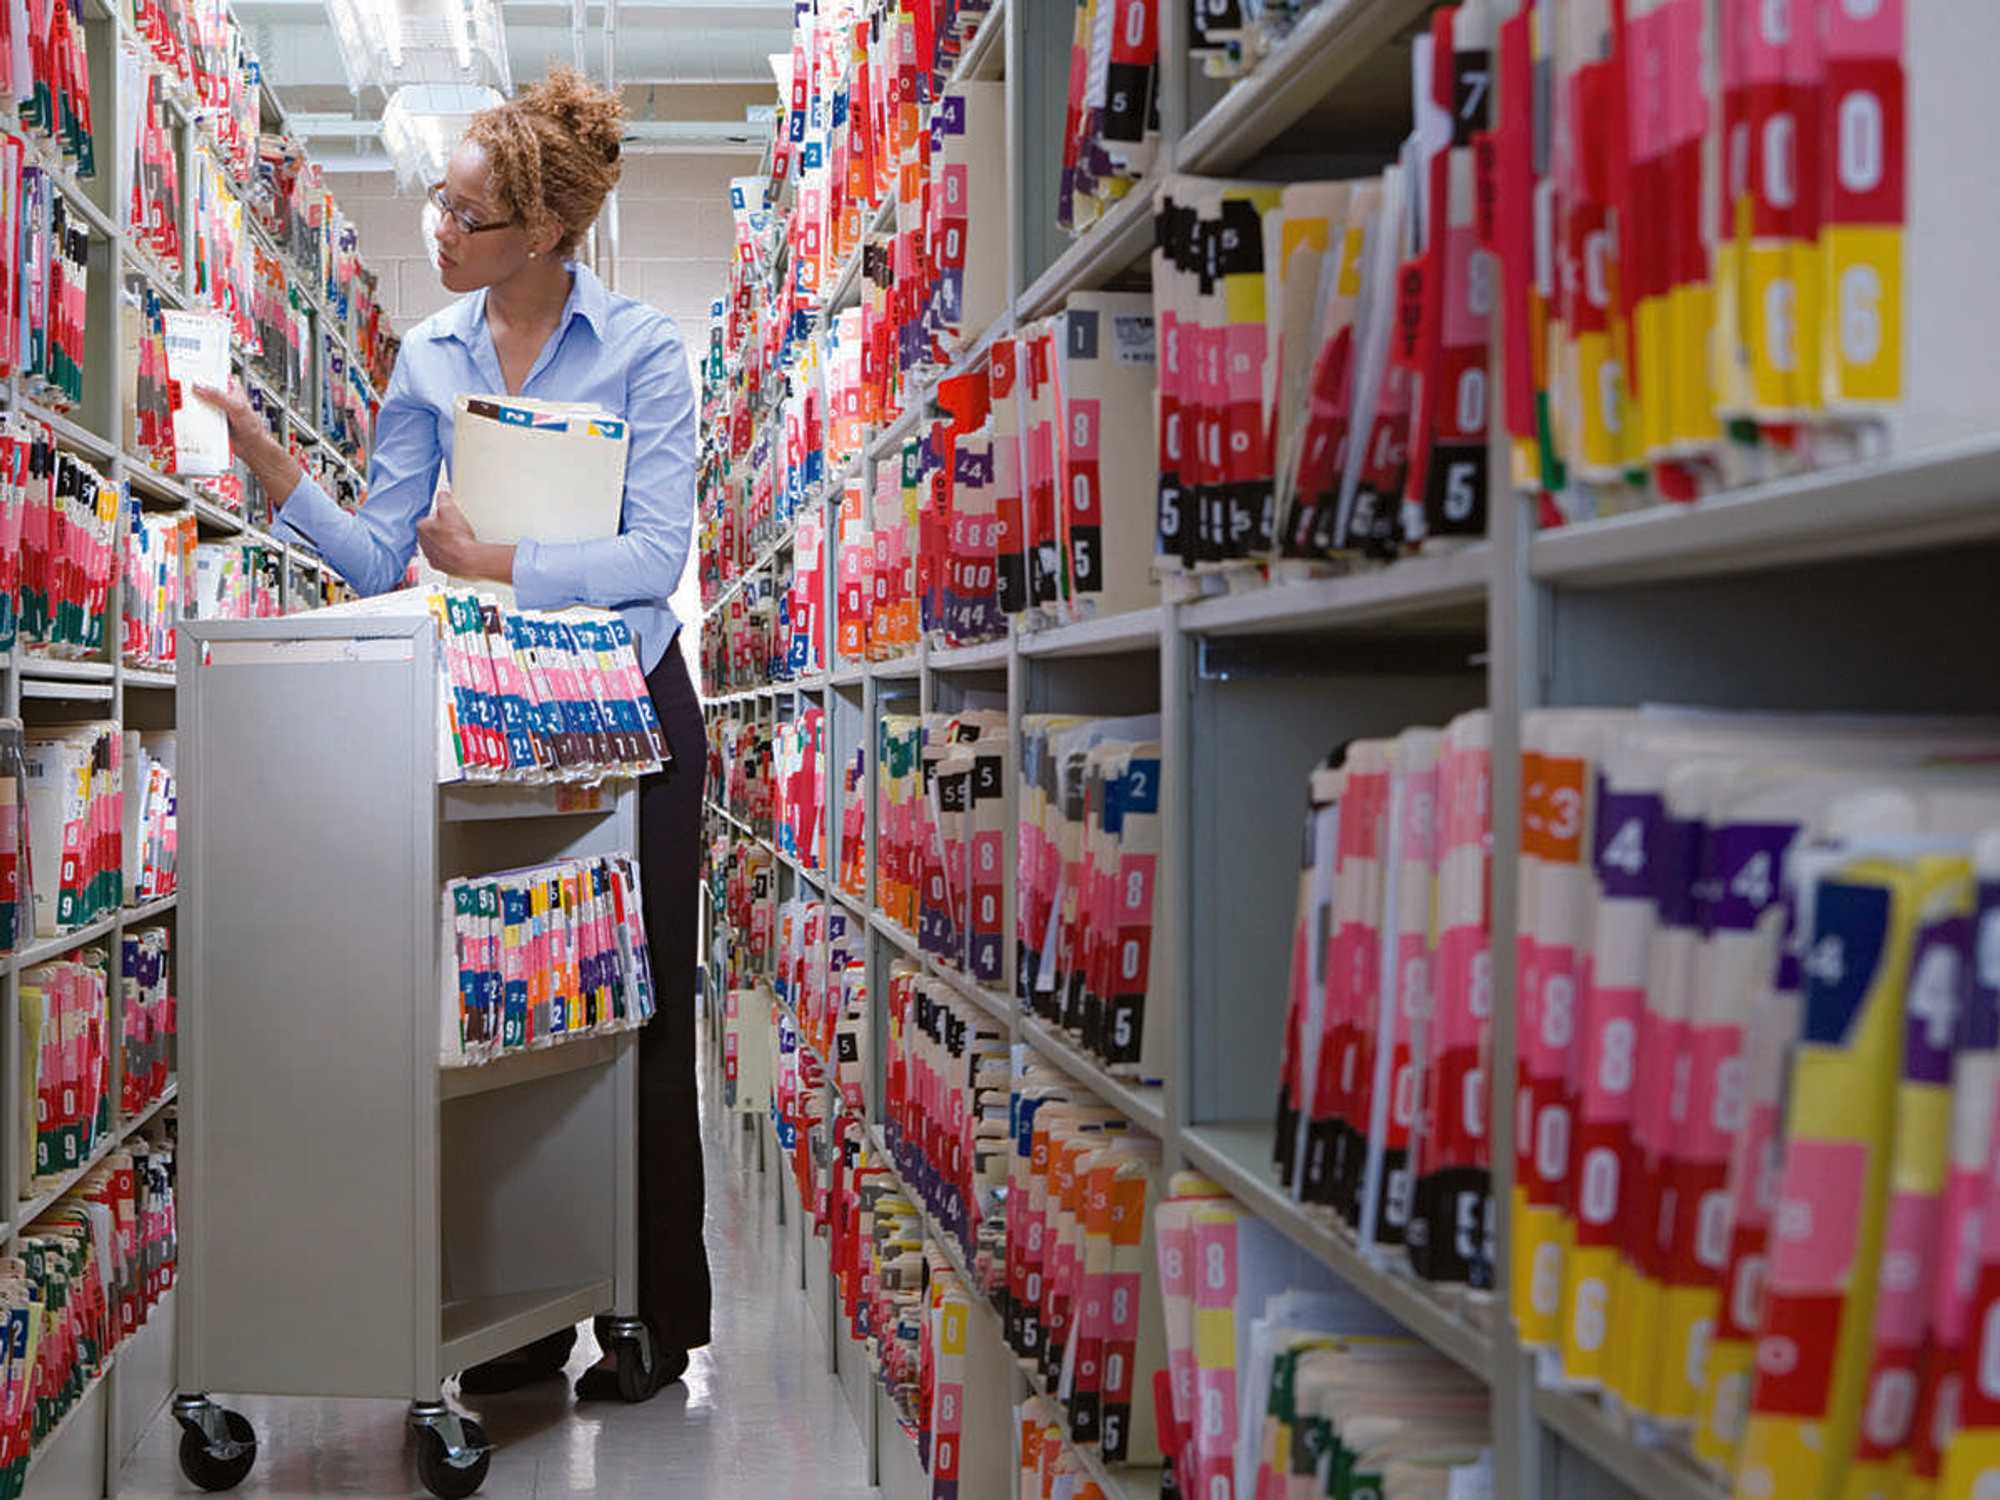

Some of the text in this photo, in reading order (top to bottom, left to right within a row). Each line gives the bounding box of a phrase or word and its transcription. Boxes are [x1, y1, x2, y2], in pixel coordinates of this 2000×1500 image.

[1112, 94, 1127, 112] 5
[1462, 74, 1489, 119] 7
[793, 118, 800, 135] 2
[945, 106, 955, 122] 4
[1839, 91, 1881, 192] 0
[947, 176, 958, 203] 8
[947, 229, 959, 258] 0
[1840, 263, 1880, 365] 6
[1076, 326, 1084, 349] 1
[1458, 369, 1484, 432] 0
[1074, 412, 1089, 447] 8
[1074, 474, 1089, 511] 0
[1444, 464, 1476, 521] 5
[1161, 489, 1180, 536] 5
[1075, 541, 1090, 578] 5
[964, 564, 975, 588] 0
[978, 564, 990, 587] 0
[796, 642, 804, 659] 2
[605, 707, 617, 725] 2
[513, 738, 523, 759] 2
[982, 767, 993, 787] 5
[1130, 771, 1147, 797] 2
[1550, 788, 1583, 839] 3
[982, 842, 993, 871] 8
[1603, 818, 1647, 876] 4
[64, 861, 74, 881] 0
[1731, 851, 1772, 907] 4
[932, 875, 943, 900] 0
[1126, 870, 1142, 908] 8
[62, 899, 73, 917] 9
[982, 895, 995, 923] 0
[982, 944, 995, 971] 4
[1123, 940, 1139, 980] 0
[1541, 975, 1573, 1048] 8
[1912, 945, 1960, 1050] 4
[1114, 1008, 1132, 1046] 5
[842, 1040, 850, 1054] 5
[1602, 1018, 1635, 1092] 8
[63, 1089, 75, 1115] 0
[64, 1134, 76, 1160] 9
[1537, 1104, 1570, 1182] 0
[1580, 1147, 1620, 1225] 0
[1207, 1243, 1225, 1289] 8
[1027, 1273, 1041, 1301] 0
[1024, 1317, 1037, 1347] 5
[1106, 1353, 1124, 1391] 0
[1105, 1415, 1120, 1450] 5
[940, 1443, 951, 1469] 0
